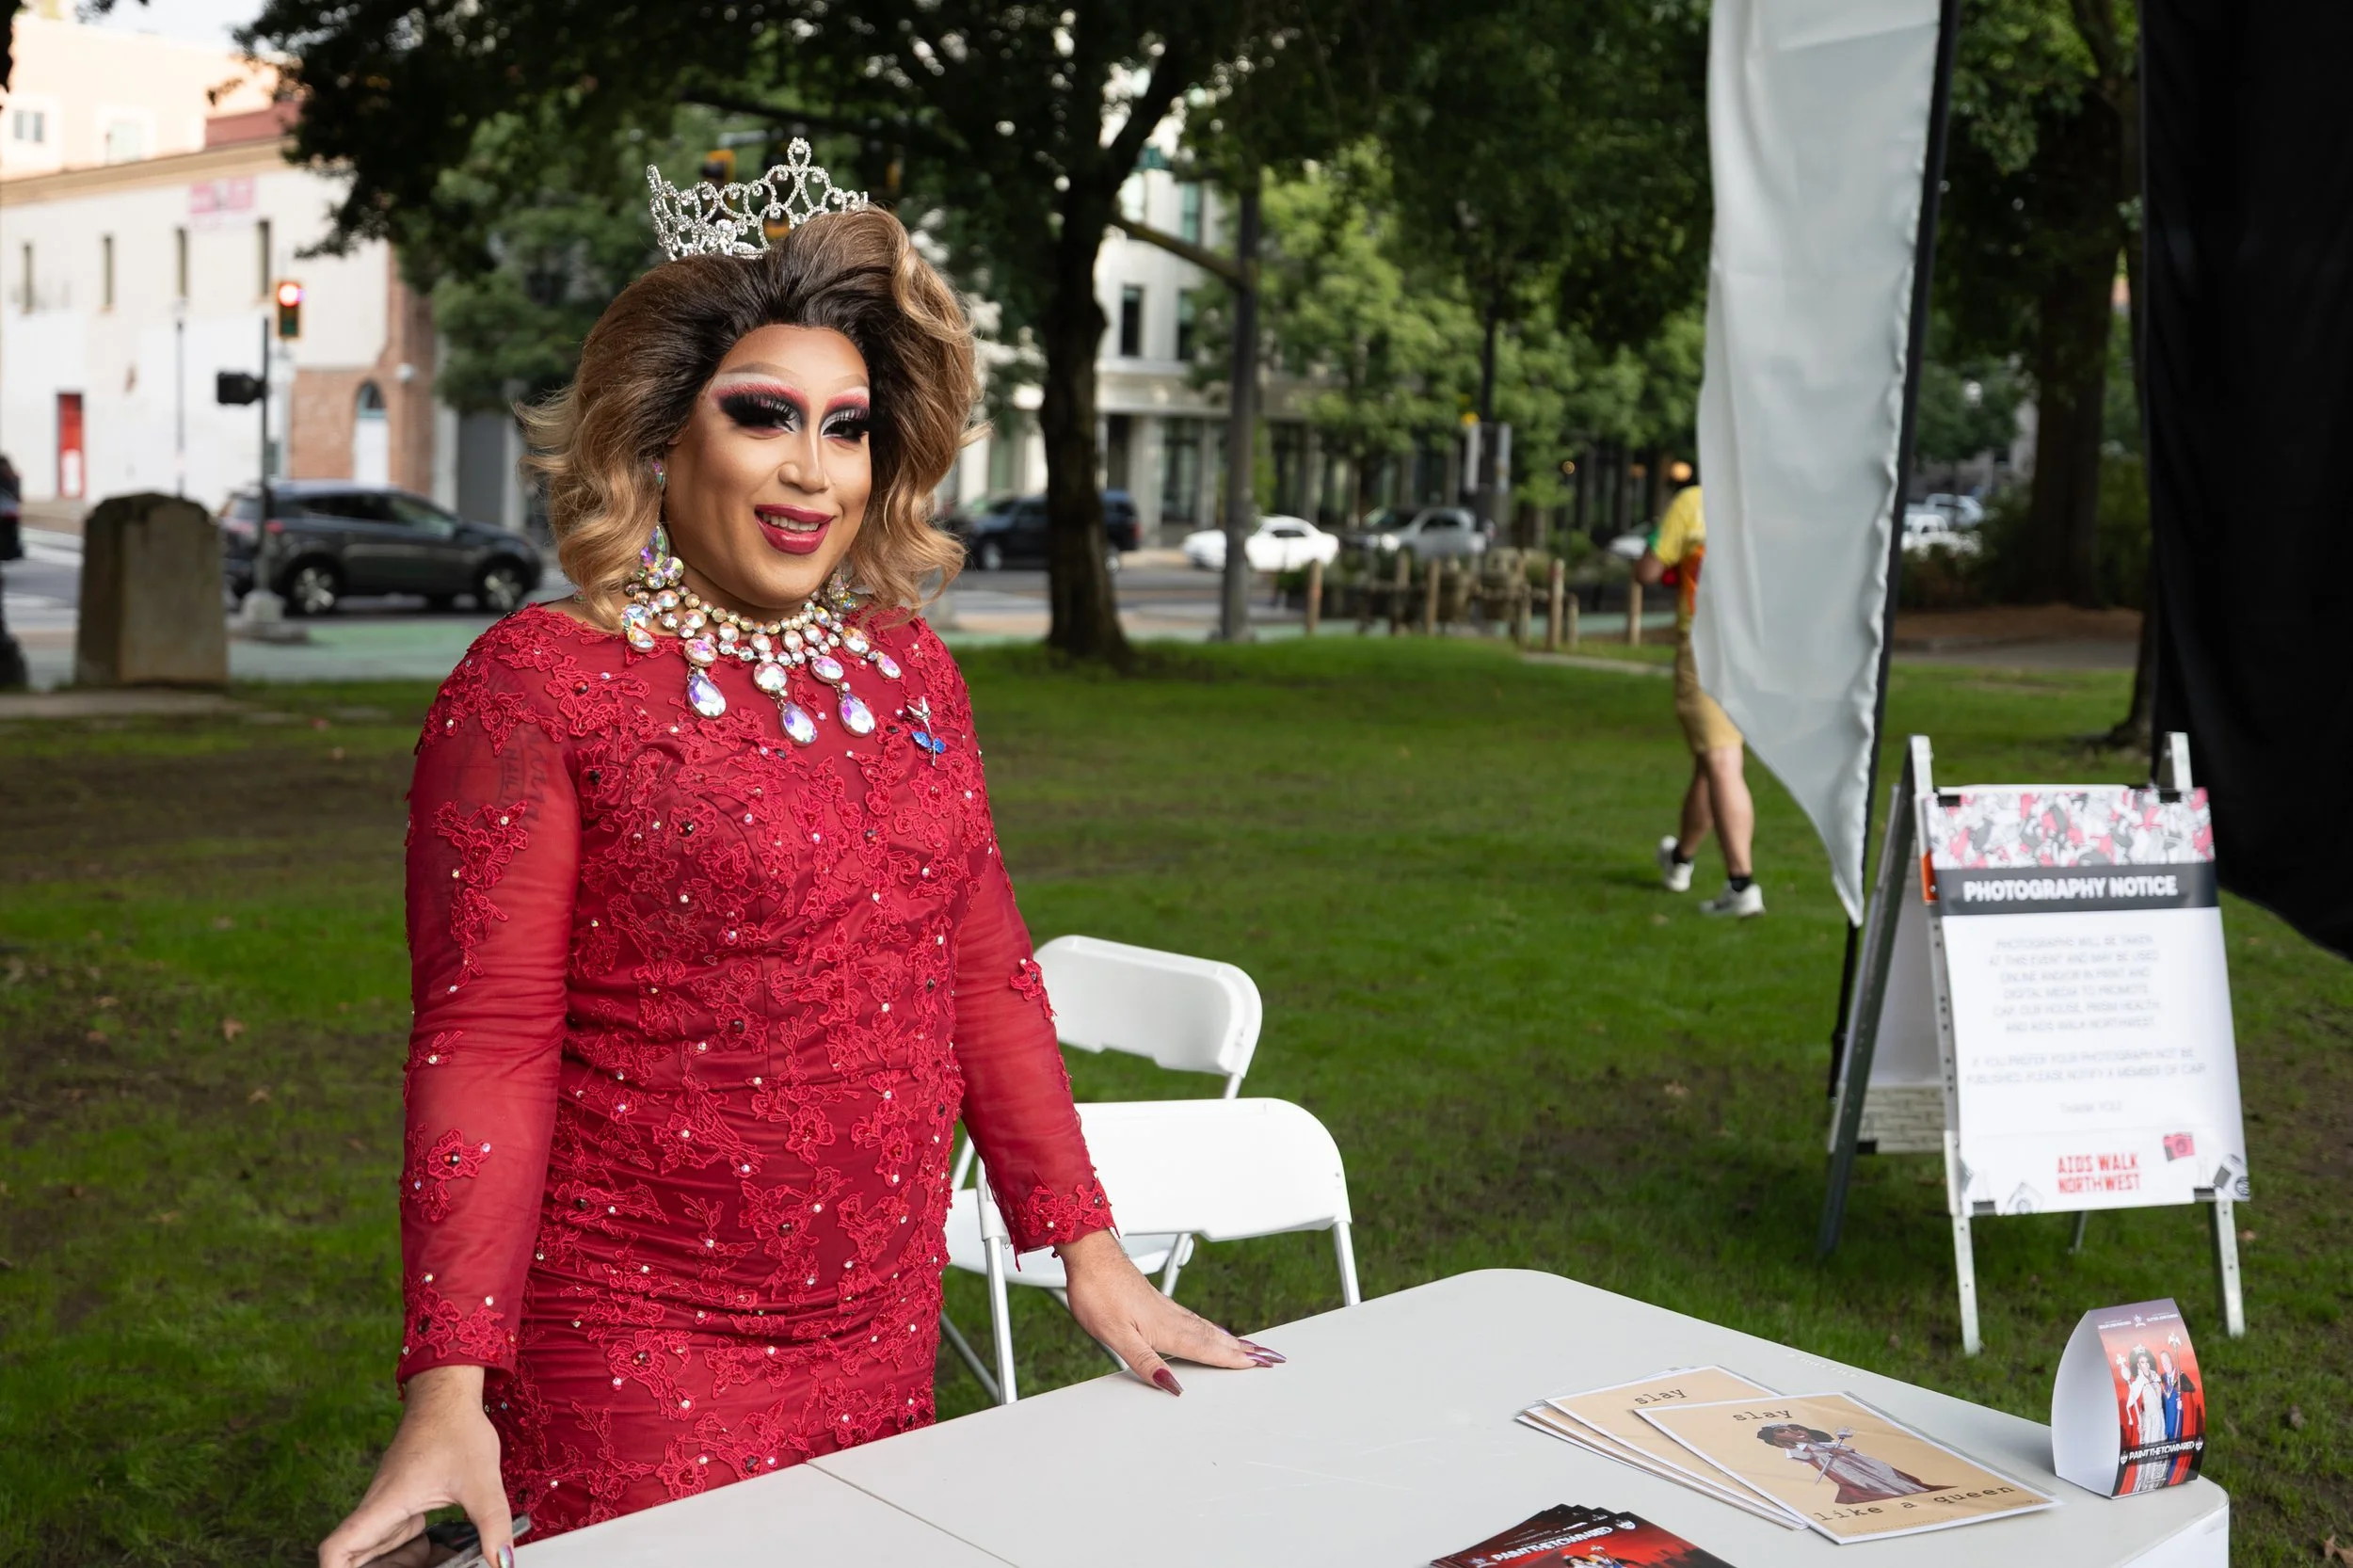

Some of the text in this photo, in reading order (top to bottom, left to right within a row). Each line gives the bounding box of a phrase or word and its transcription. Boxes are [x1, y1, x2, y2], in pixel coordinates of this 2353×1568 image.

[1963, 875, 2178, 902] PHOTOGRAPHY NOTICE
[2105, 935, 2117, 946] BE
[2005, 953, 2027, 966] THIS
[2031, 952, 2062, 966] EVENT
[2116, 951, 2129, 962] BE
[2057, 1153, 2139, 1175] AIDS WALK
[2058, 1174, 2141, 1193] NORTHWEST
[1634, 1388, 1688, 1405] slay
[1733, 1409, 1794, 1422] slay
[1813, 1486, 2015, 1522] like a queen
